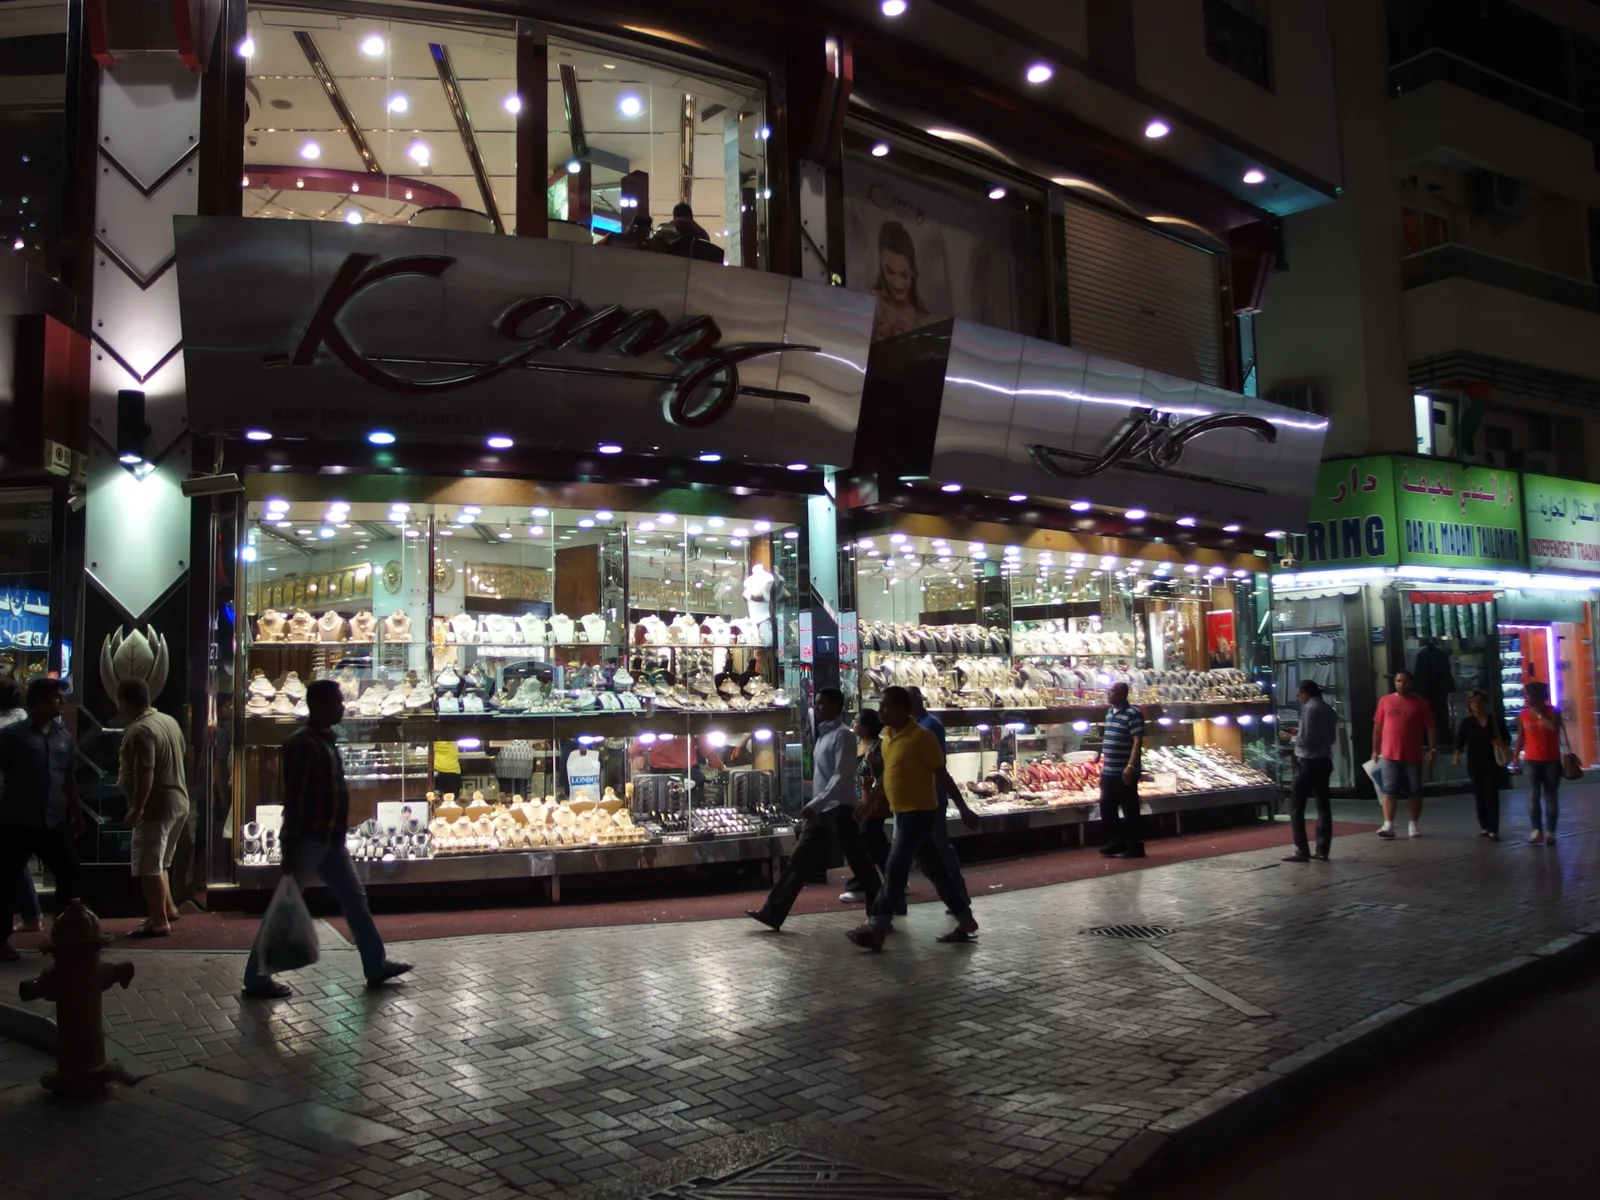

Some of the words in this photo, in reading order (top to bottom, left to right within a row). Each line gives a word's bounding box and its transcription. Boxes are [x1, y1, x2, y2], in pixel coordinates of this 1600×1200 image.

[1405, 518, 1425, 554] DAR
[1530, 537, 1575, 559] INDEPENDENT
[1576, 542, 1600, 562] TRADIN
